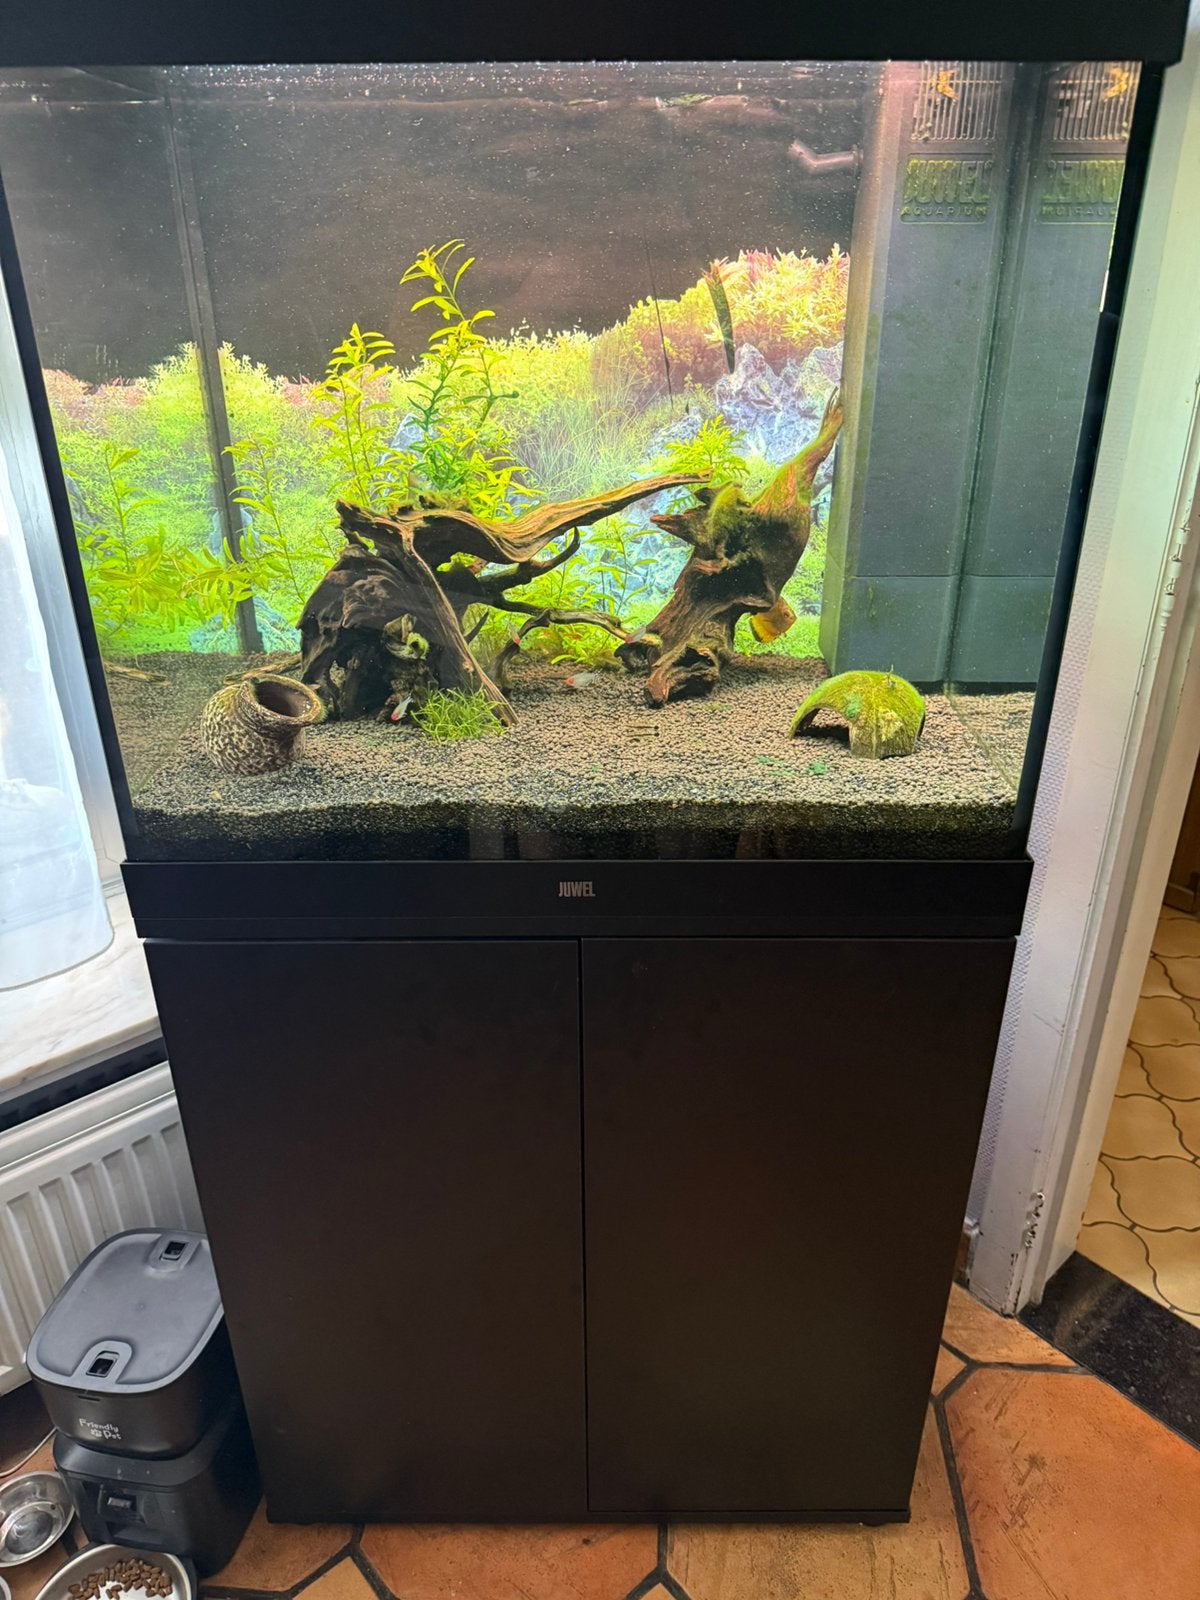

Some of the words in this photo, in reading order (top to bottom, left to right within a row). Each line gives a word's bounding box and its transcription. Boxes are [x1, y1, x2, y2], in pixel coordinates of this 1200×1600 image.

[559, 881, 596, 897] JUWEL
[79, 1418, 119, 1432] Friendly
[104, 1430, 122, 1440] Pet
